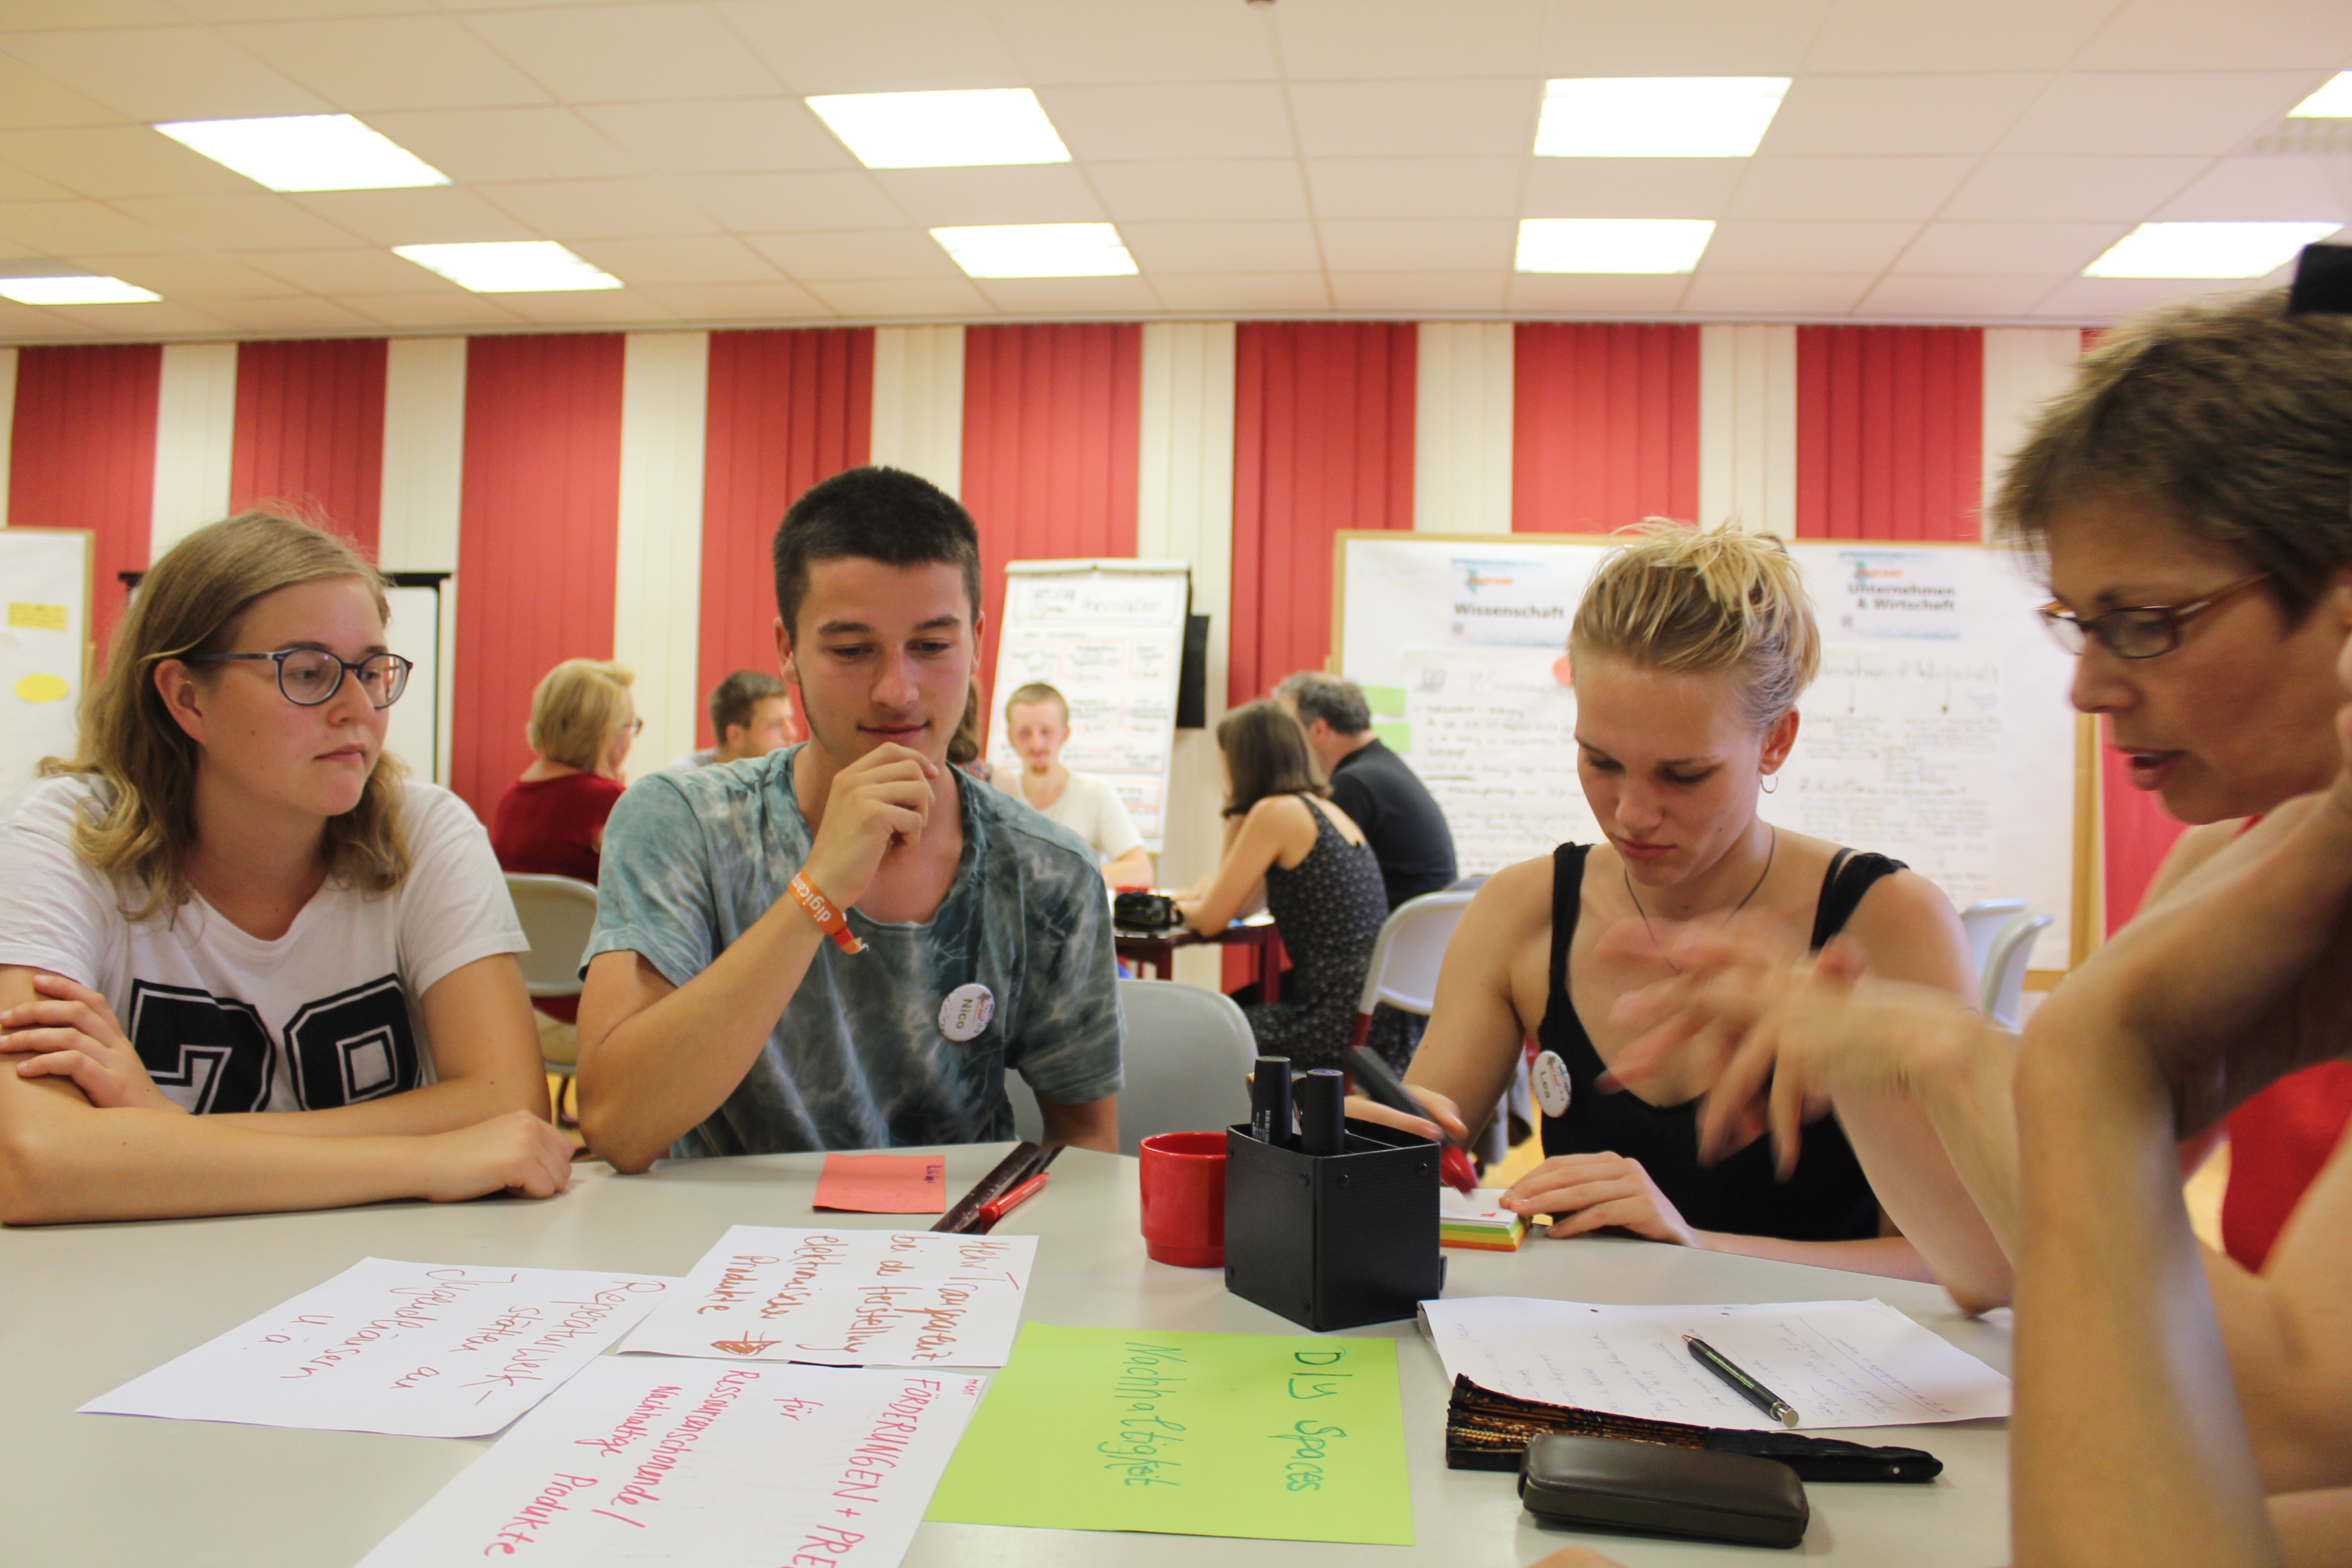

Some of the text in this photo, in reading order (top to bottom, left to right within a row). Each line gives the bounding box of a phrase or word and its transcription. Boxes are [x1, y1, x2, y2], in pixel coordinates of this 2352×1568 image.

[1454, 602, 1565, 619] Wissenschaft
[1847, 583, 1956, 596] Unternehmen
[1874, 598, 1955, 610] Wirtschaft
[956, 998, 974, 1030] Nico
[697, 1255, 780, 1315] Produkte
[574, 1385, 682, 1457] Nachhaltige
[773, 1396, 825, 1422] für
[1096, 1341, 1190, 1488] Nachhaltigkeit
[1267, 1419, 1349, 1492] Spaces
[483, 1473, 599, 1557] Produkte
[780, 1524, 865, 1568] PRE
